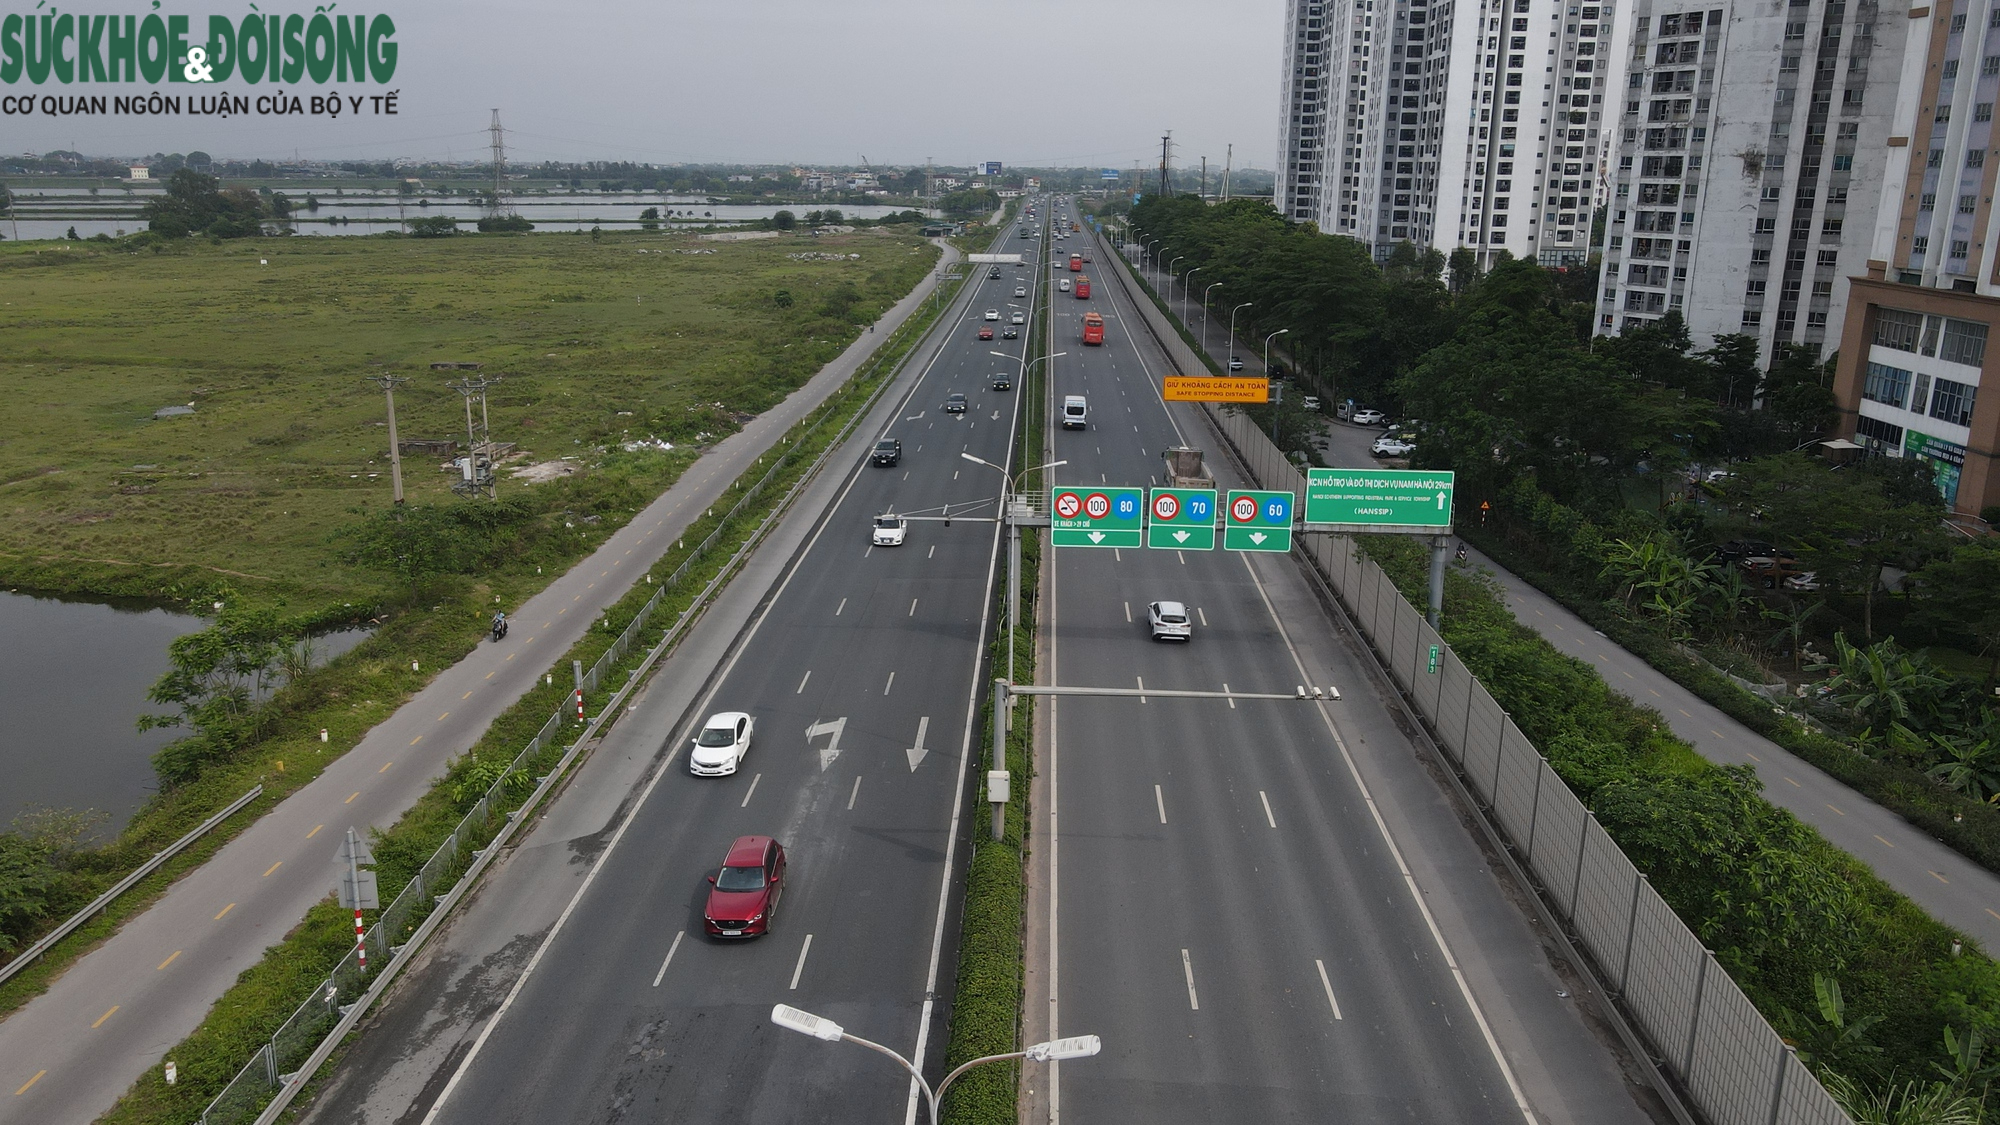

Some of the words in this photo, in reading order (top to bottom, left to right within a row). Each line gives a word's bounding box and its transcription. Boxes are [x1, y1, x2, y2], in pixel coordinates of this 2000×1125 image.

[1166, 380, 1178, 388] GIỮ
[1213, 380, 1234, 389] CÁCH
[1309, 478, 1322, 486] KCN
[1346, 477, 1353, 487] VÀ
[1365, 479, 1373, 489] THỊ
[1374, 480, 1389, 489] DỊCH
[1390, 480, 1398, 489] VỤ
[1399, 480, 1414, 488] NAM
[1414, 478, 1422, 488] HÀ
[1423, 479, 1434, 490] NỘI
[1090, 500, 1105, 511] 100
[1120, 500, 1133, 512] 80
[1160, 501, 1174, 512] 100
[1192, 502, 1206, 514] 70
[1237, 504, 1252, 515] 100
[1269, 504, 1282, 516] 60
